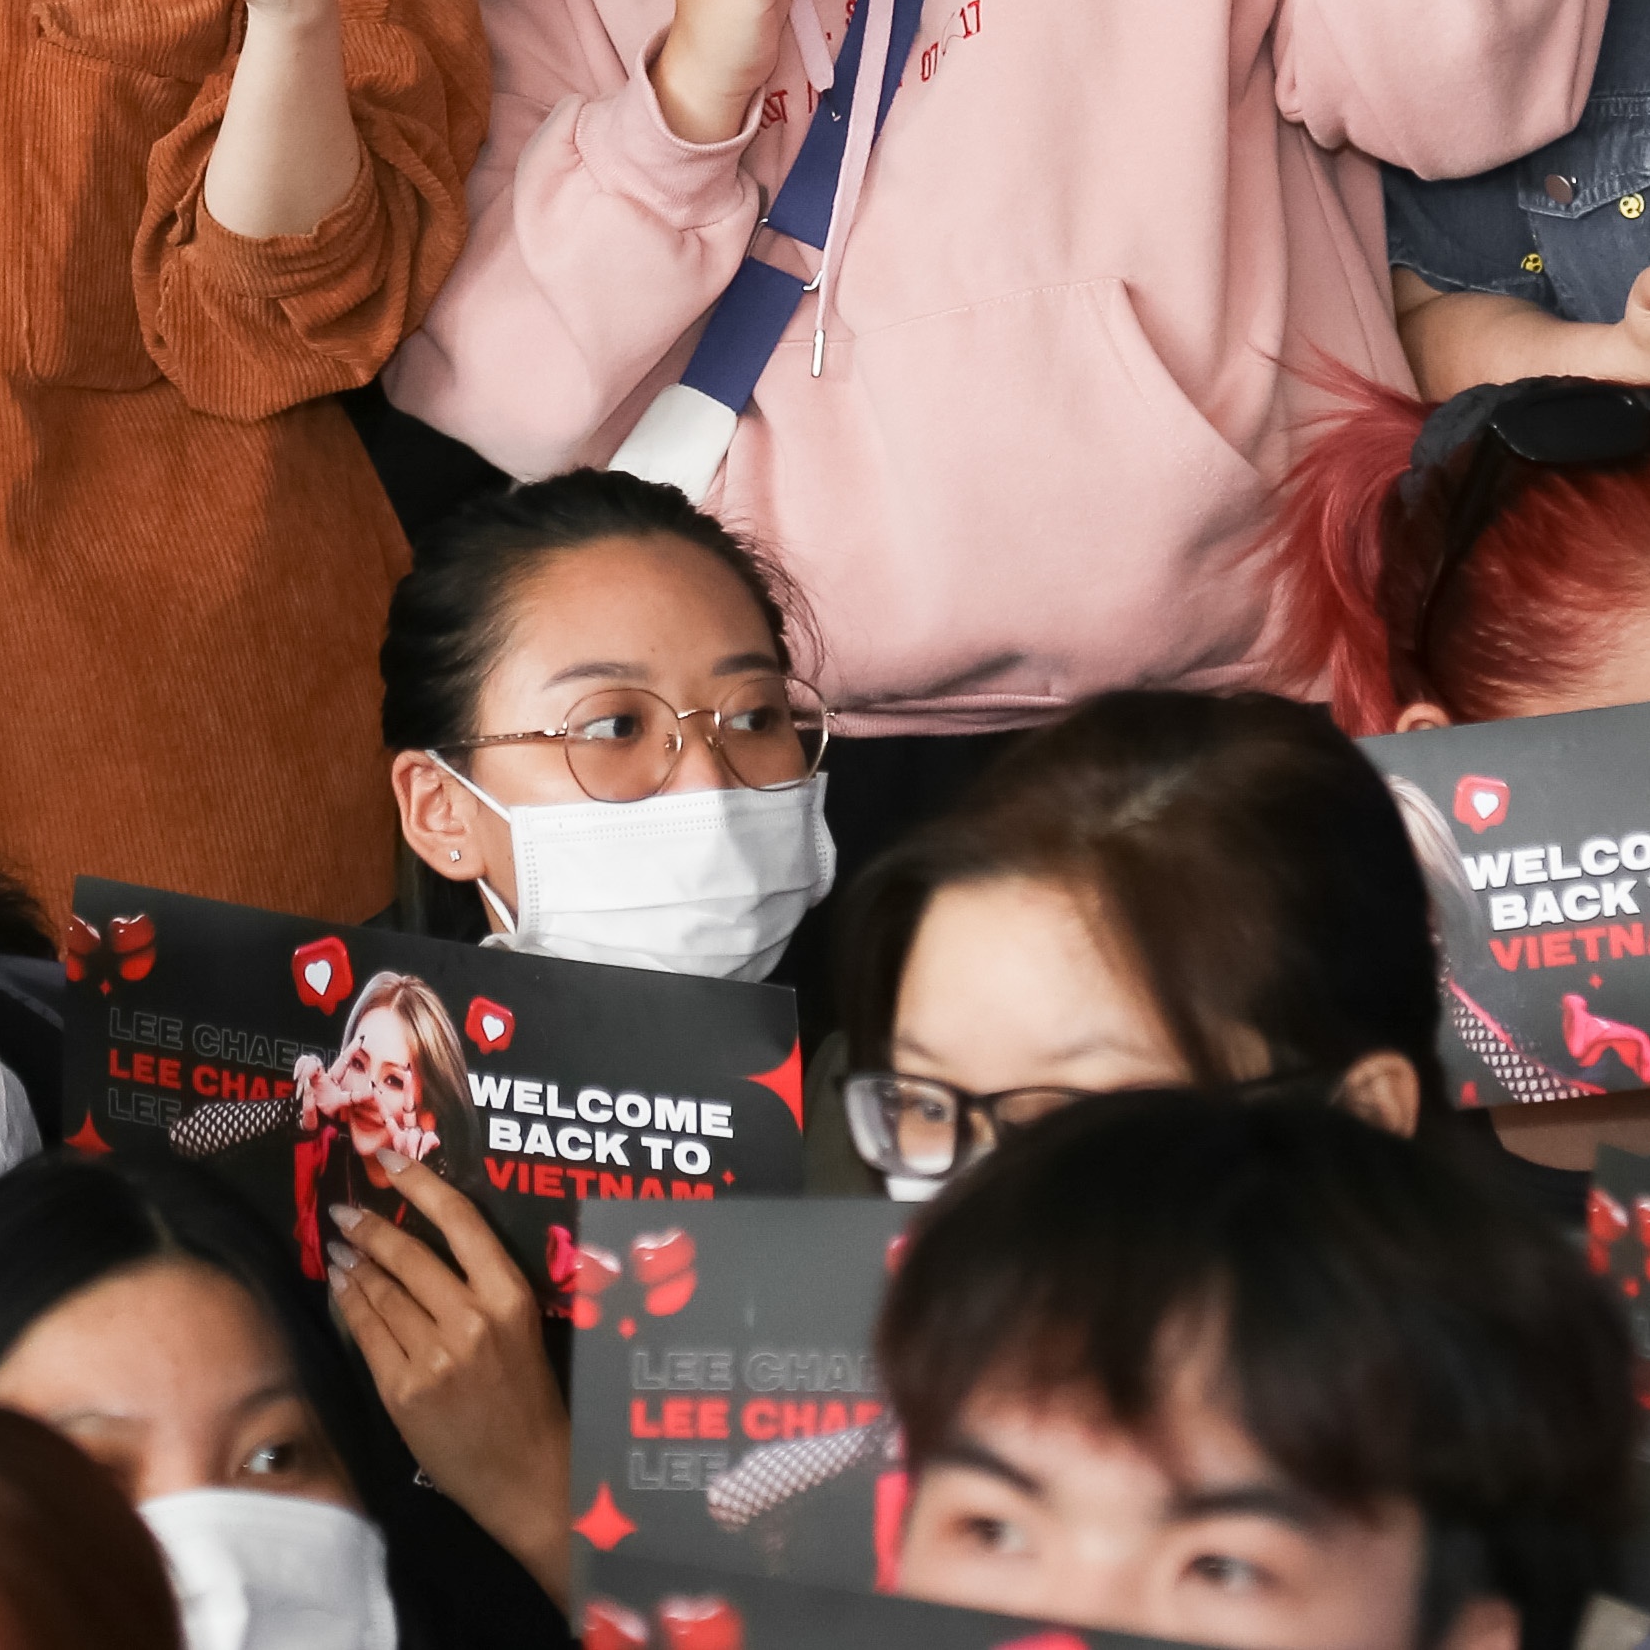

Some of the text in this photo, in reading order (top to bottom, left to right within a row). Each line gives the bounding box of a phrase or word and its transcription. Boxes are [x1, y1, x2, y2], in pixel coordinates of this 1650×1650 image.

[1490, 879, 1641, 931] BACK
[110, 1007, 183, 1050] LEE
[109, 1048, 182, 1090] LEE
[467, 1073, 735, 1140] WELCOME
[489, 1117, 712, 1175] BACK TO
[484, 1157, 715, 1201] VIETNAM
[631, 1351, 733, 1391] LEE
[630, 1398, 730, 1440] LEE
